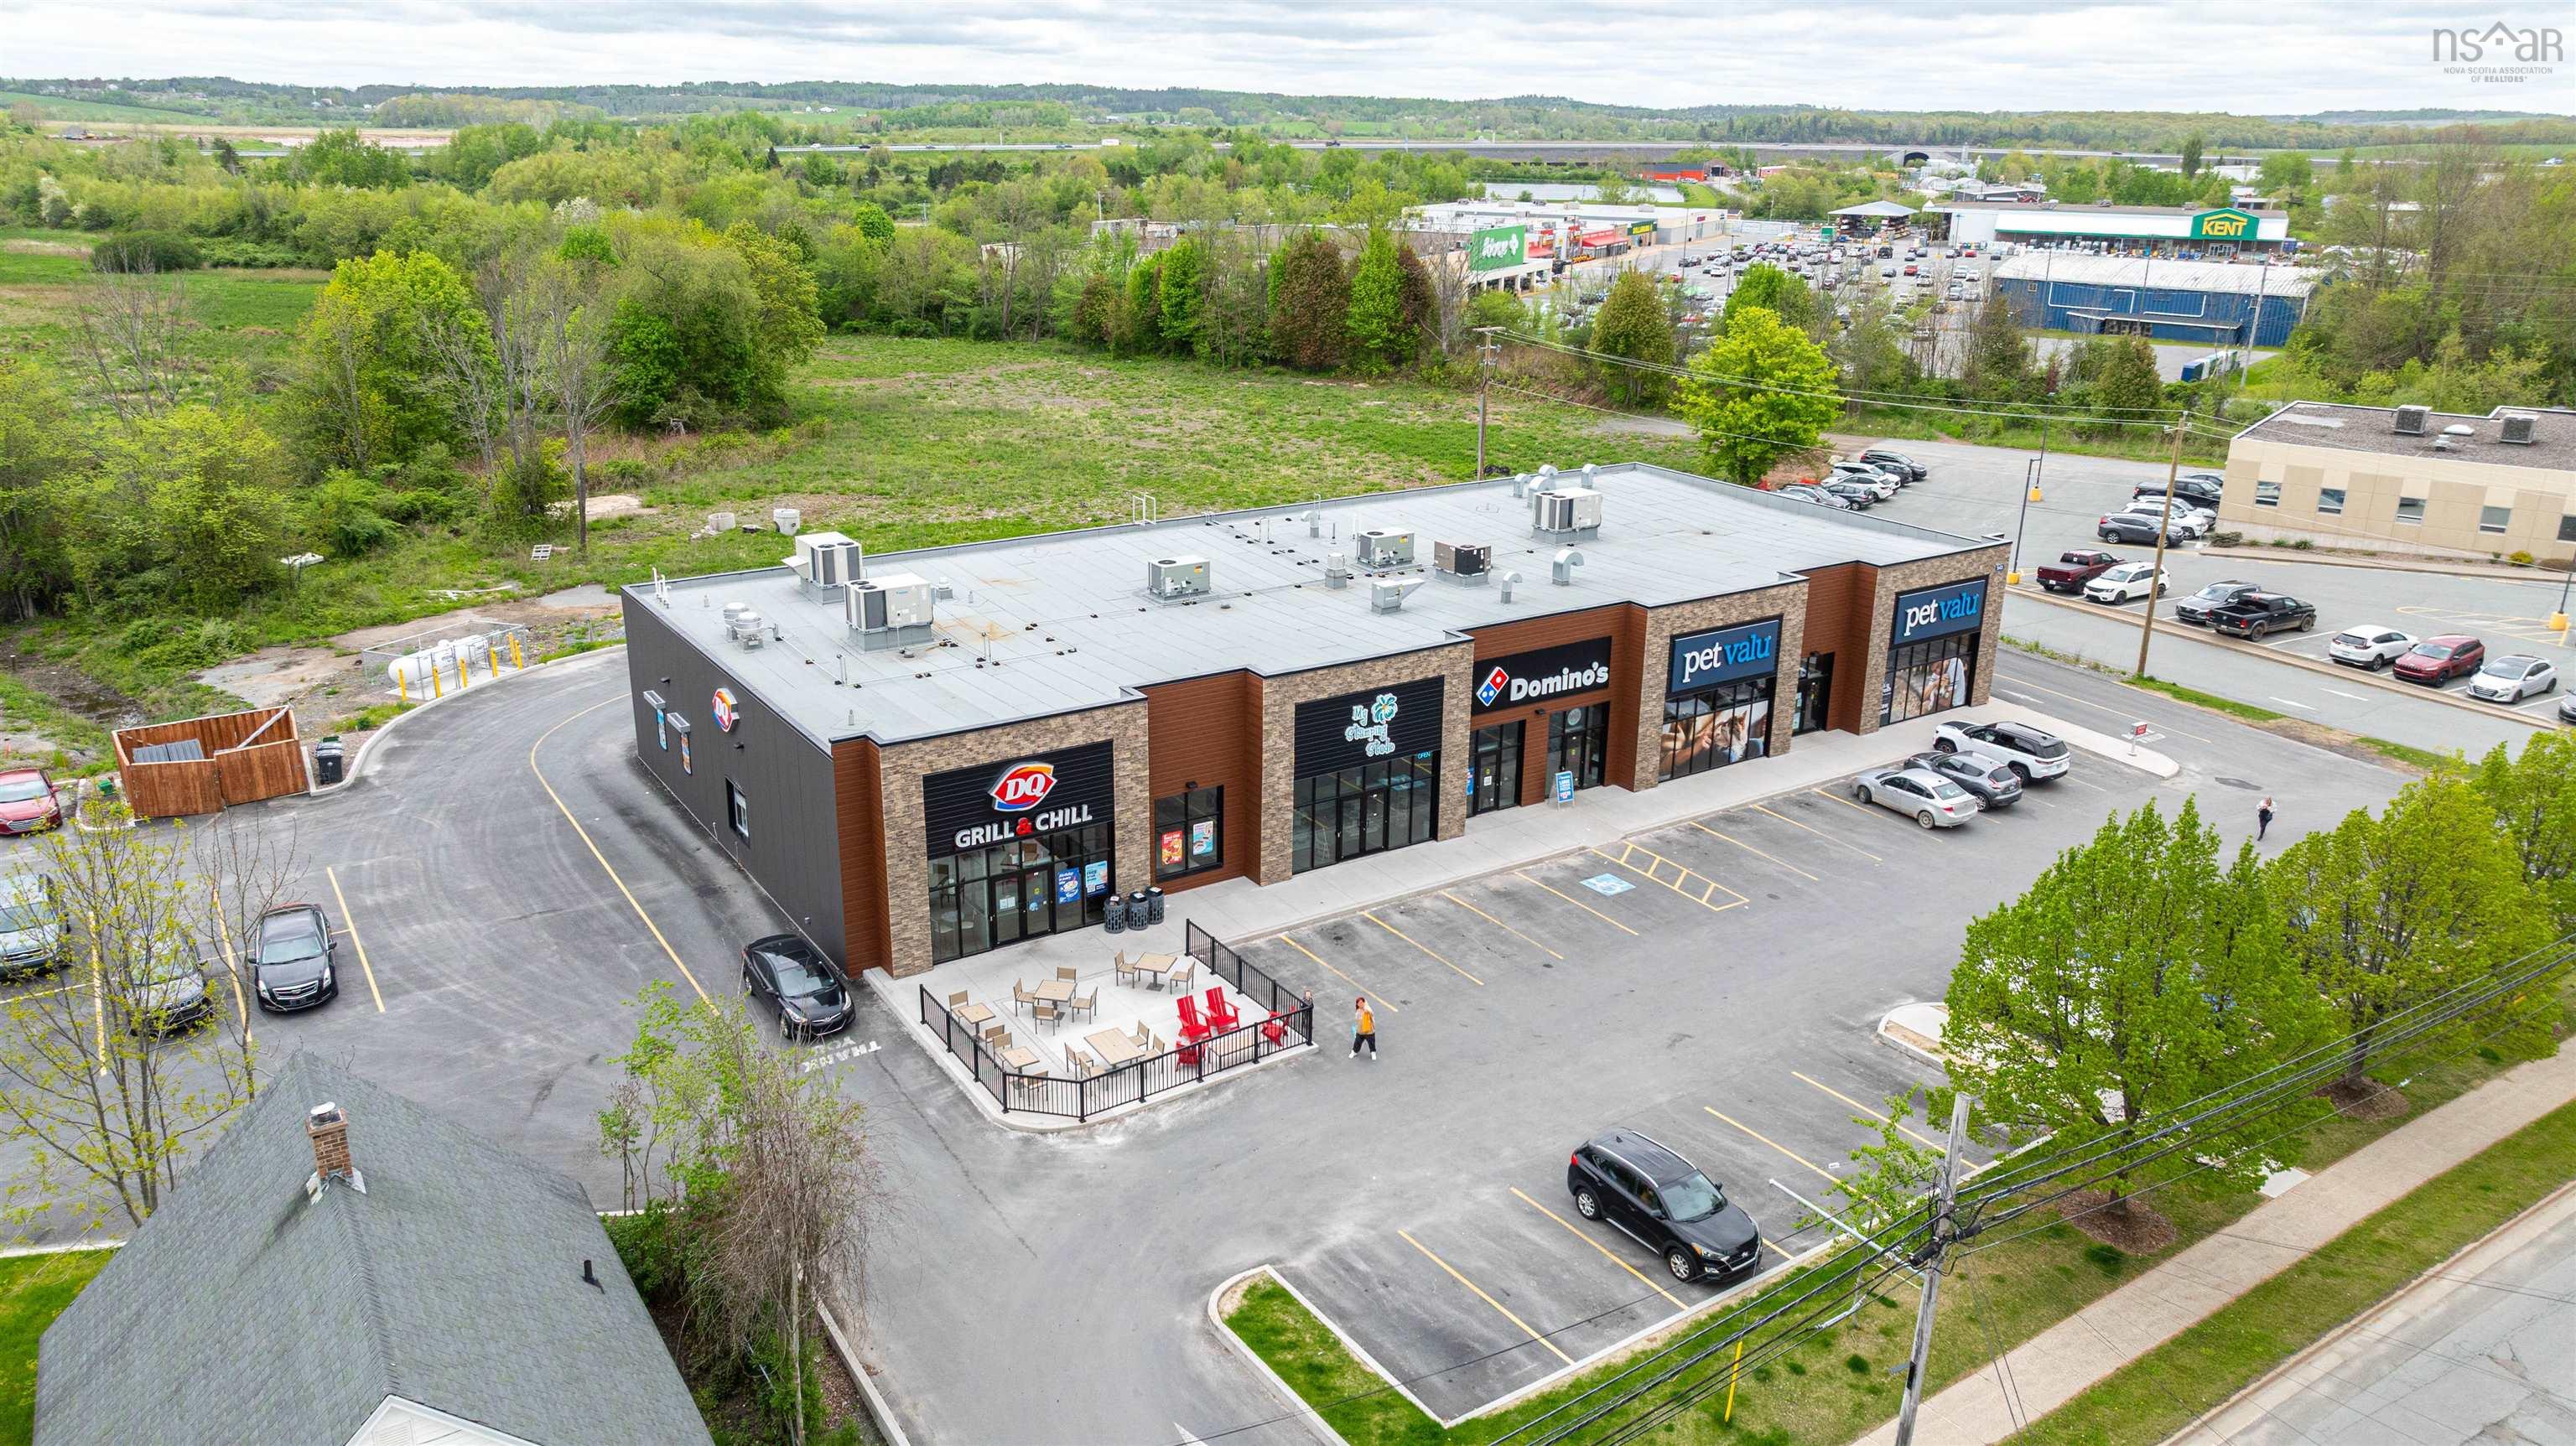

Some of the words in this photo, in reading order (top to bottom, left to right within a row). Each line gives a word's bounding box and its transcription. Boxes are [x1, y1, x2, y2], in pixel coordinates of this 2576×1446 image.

[2202, 220, 2247, 236] KENT
[1903, 599, 1938, 636] pet
[1939, 591, 1978, 621] valu
[1682, 641, 1722, 683] pet
[1723, 634, 1771, 666] valu
[1509, 661, 1609, 701] Domino's
[714, 697, 729, 727] DQ
[1352, 705, 1368, 726] My
[1345, 723, 1389, 742] Stamping
[1365, 738, 1396, 757] Studio
[1417, 751, 1431, 759] OPEN
[1005, 773, 1046, 801] DQ
[954, 821, 1015, 848] GRILL
[1015, 817, 1033, 836] &
[1035, 804, 1093, 831] CHILL
